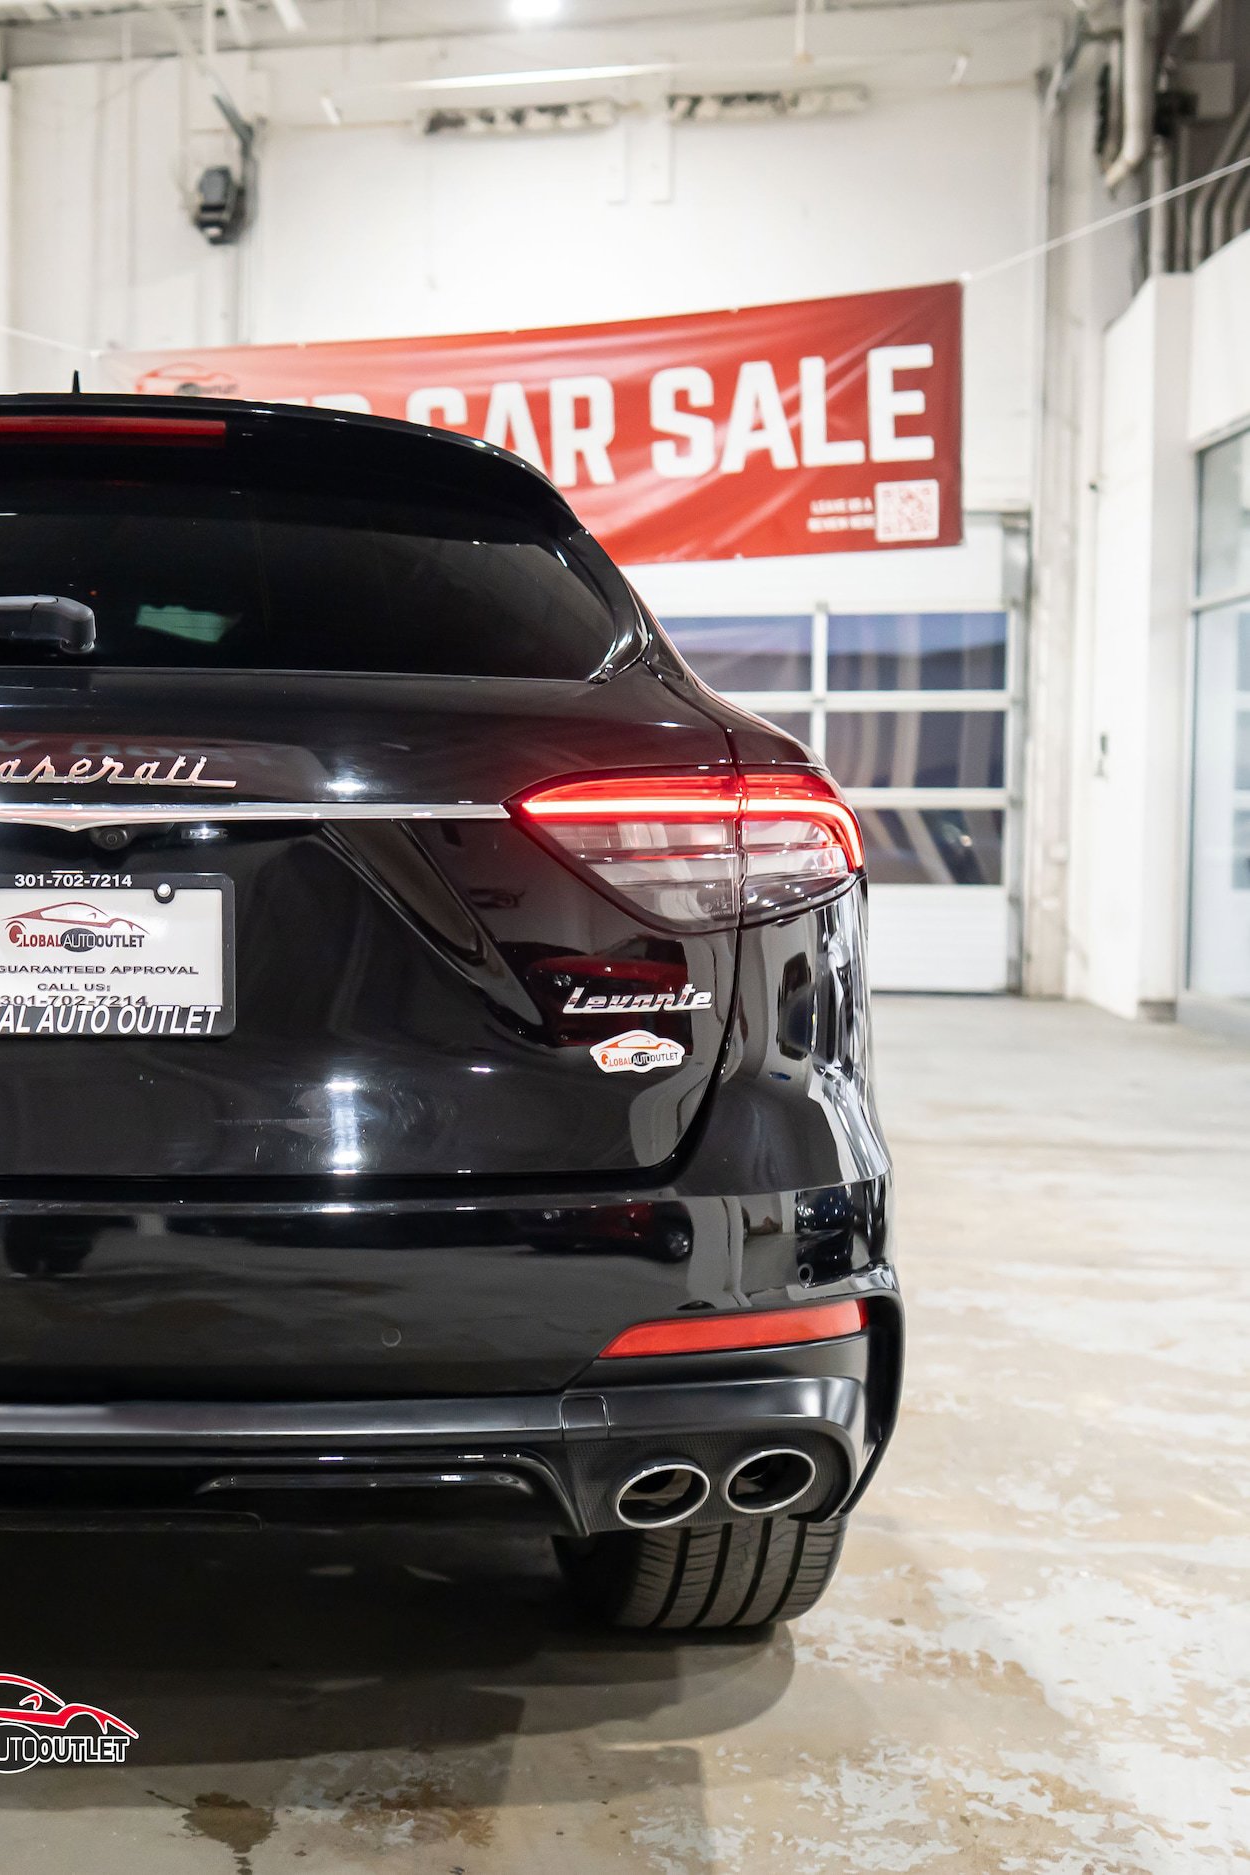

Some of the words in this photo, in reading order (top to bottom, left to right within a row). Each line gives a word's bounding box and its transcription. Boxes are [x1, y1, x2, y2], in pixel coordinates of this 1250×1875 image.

[649, 343, 935, 478] SALE
[14, 873, 133, 888] 301-702-7214
[110, 965, 200, 975] APPROVAL
[37, 983, 80, 992] CALL
[83, 983, 112, 992] US:
[0, 995, 149, 1007] 301-702-7214
[562, 983, 713, 1014] Levante
[36, 1004, 112, 1034] AUTO
[116, 1004, 222, 1034] OUTLET
